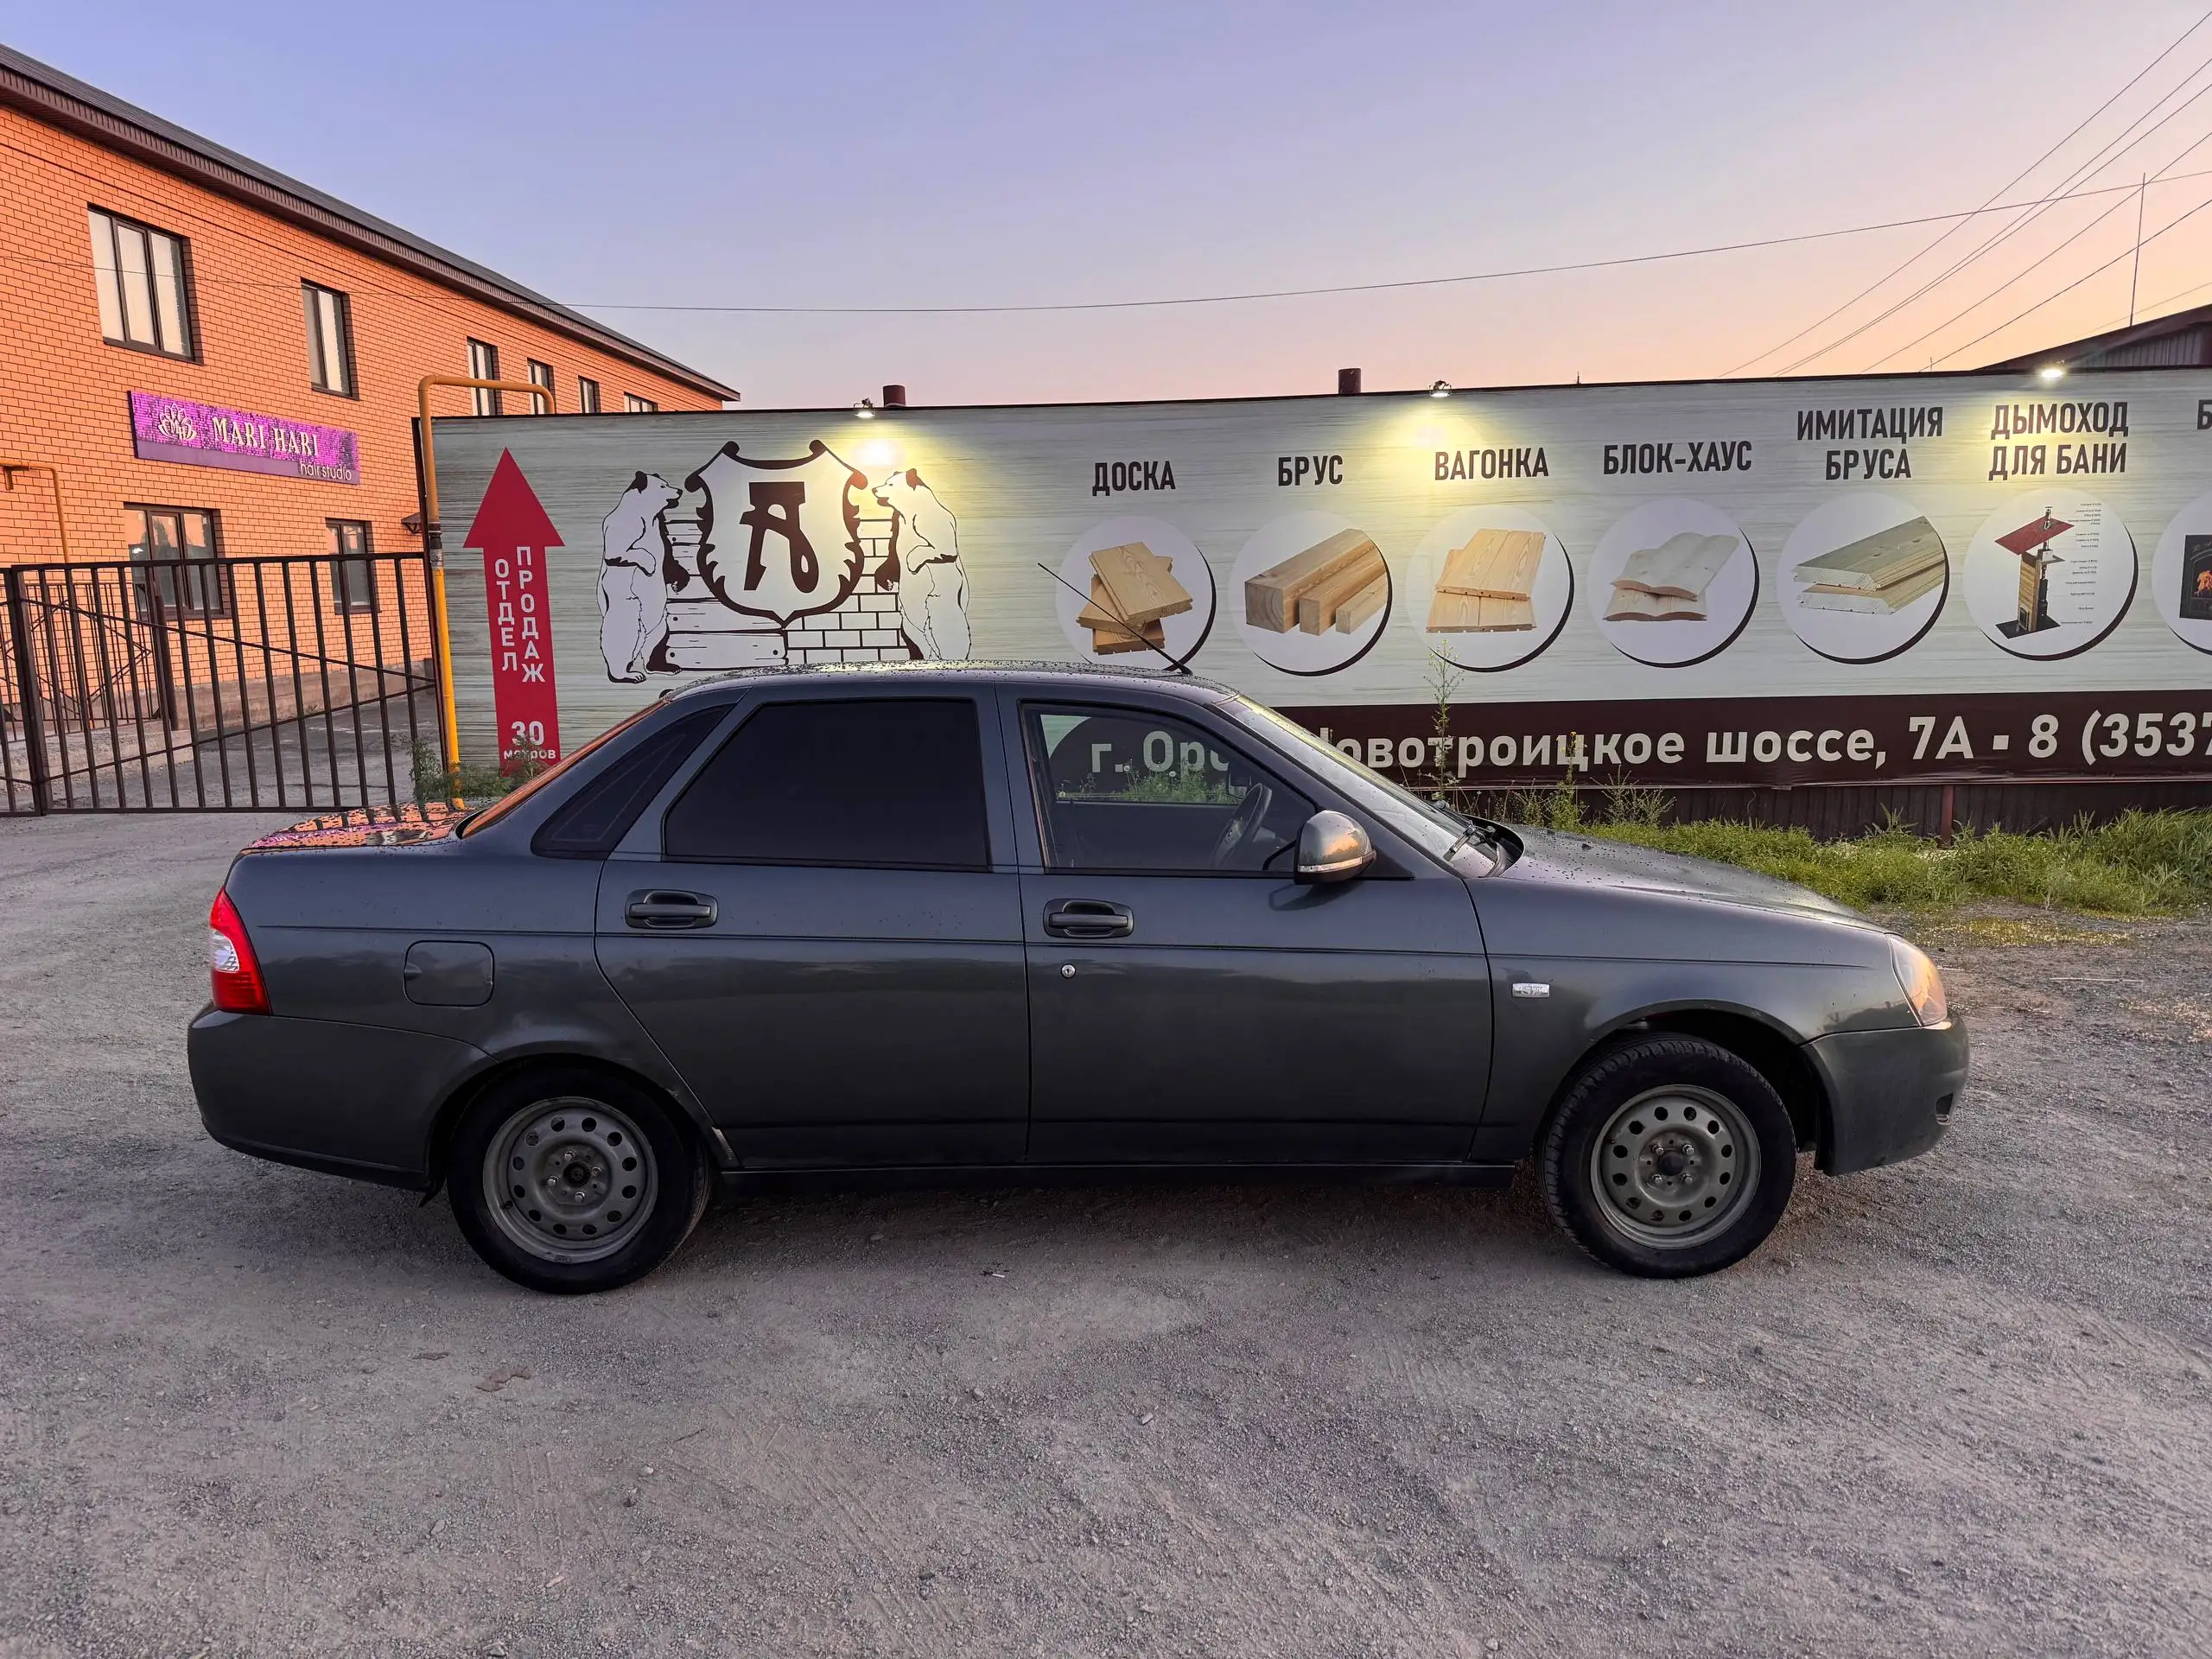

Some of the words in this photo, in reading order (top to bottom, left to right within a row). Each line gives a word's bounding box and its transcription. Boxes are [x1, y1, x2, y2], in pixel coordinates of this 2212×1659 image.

[212, 416, 265, 448] MARI
[272, 428, 318, 456] HARI
[1797, 406, 1943, 444] ИМИТАЦИЯ
[1991, 402, 2129, 441] ДЫМОХОД
[300, 460, 321, 476] hair
[321, 465, 353, 480] studio
[1278, 454, 1344, 486] БРУС
[1434, 447, 1549, 480] ВАГОНКА
[1604, 441, 1752, 474] БЛОК-ХАУС
[1825, 448, 1911, 480] БРУСА
[1988, 445, 2045, 481] ДЛЯ
[2056, 442, 2127, 474] БАНИ
[1092, 461, 1176, 497] ДОСКА
[494, 558, 518, 671] ОТДЕЛ
[516, 546, 546, 683] ПРОДАЖ
[511, 721, 544, 746] 30
[1091, 743, 1123, 773] г.
[1320, 727, 1685, 778] овотроицкое
[1706, 728, 1886, 770] шоссе,
[1908, 715, 1974, 760] 7А
[2028, 714, 2059, 759] 8
